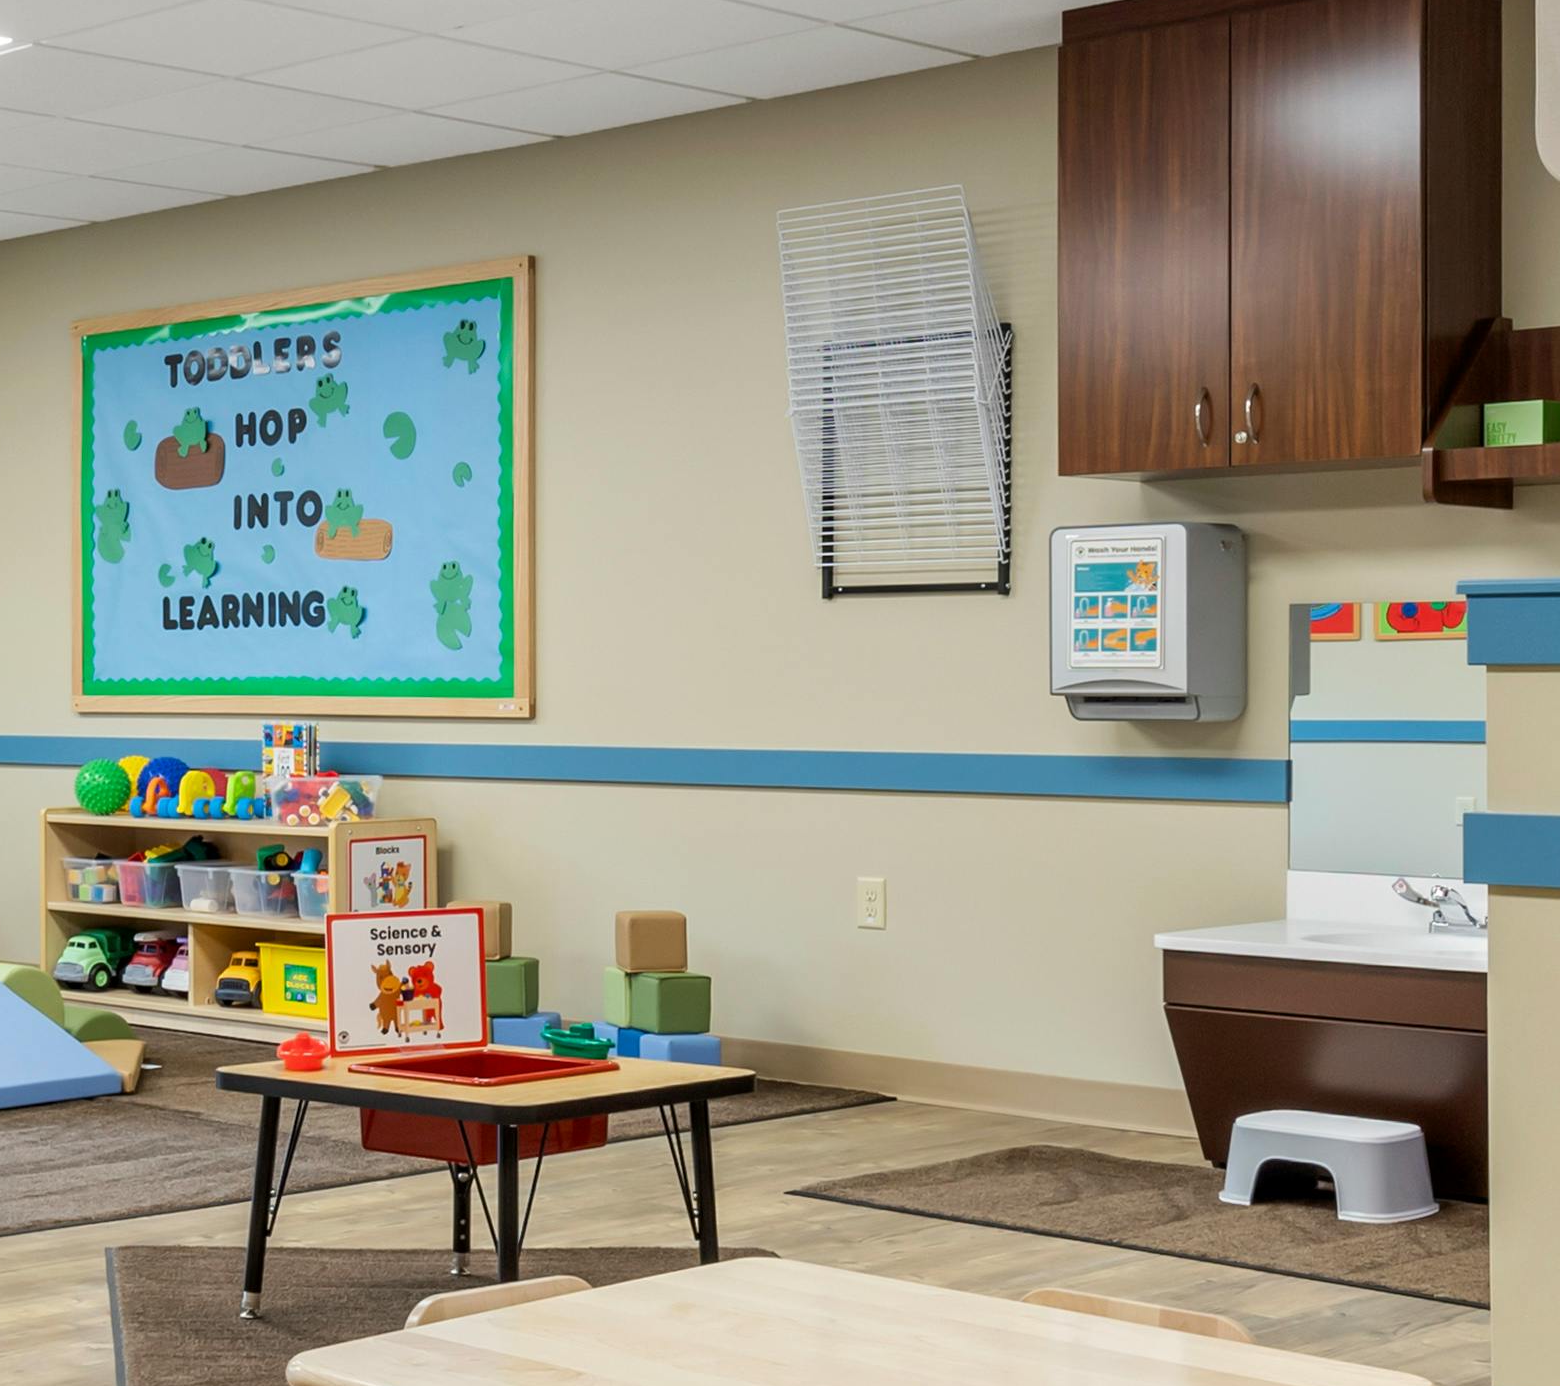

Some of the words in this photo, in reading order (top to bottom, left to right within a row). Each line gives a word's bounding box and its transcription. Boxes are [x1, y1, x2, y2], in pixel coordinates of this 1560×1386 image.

[164, 330, 343, 388] TODDLERS
[235, 407, 307, 448] HOP
[233, 488, 323, 530] INTO
[162, 589, 326, 631] LEARNING
[376, 846, 399, 855] Blocks
[370, 925, 427, 941] Science
[431, 925, 442, 938] &
[376, 942, 437, 958] Sensory
